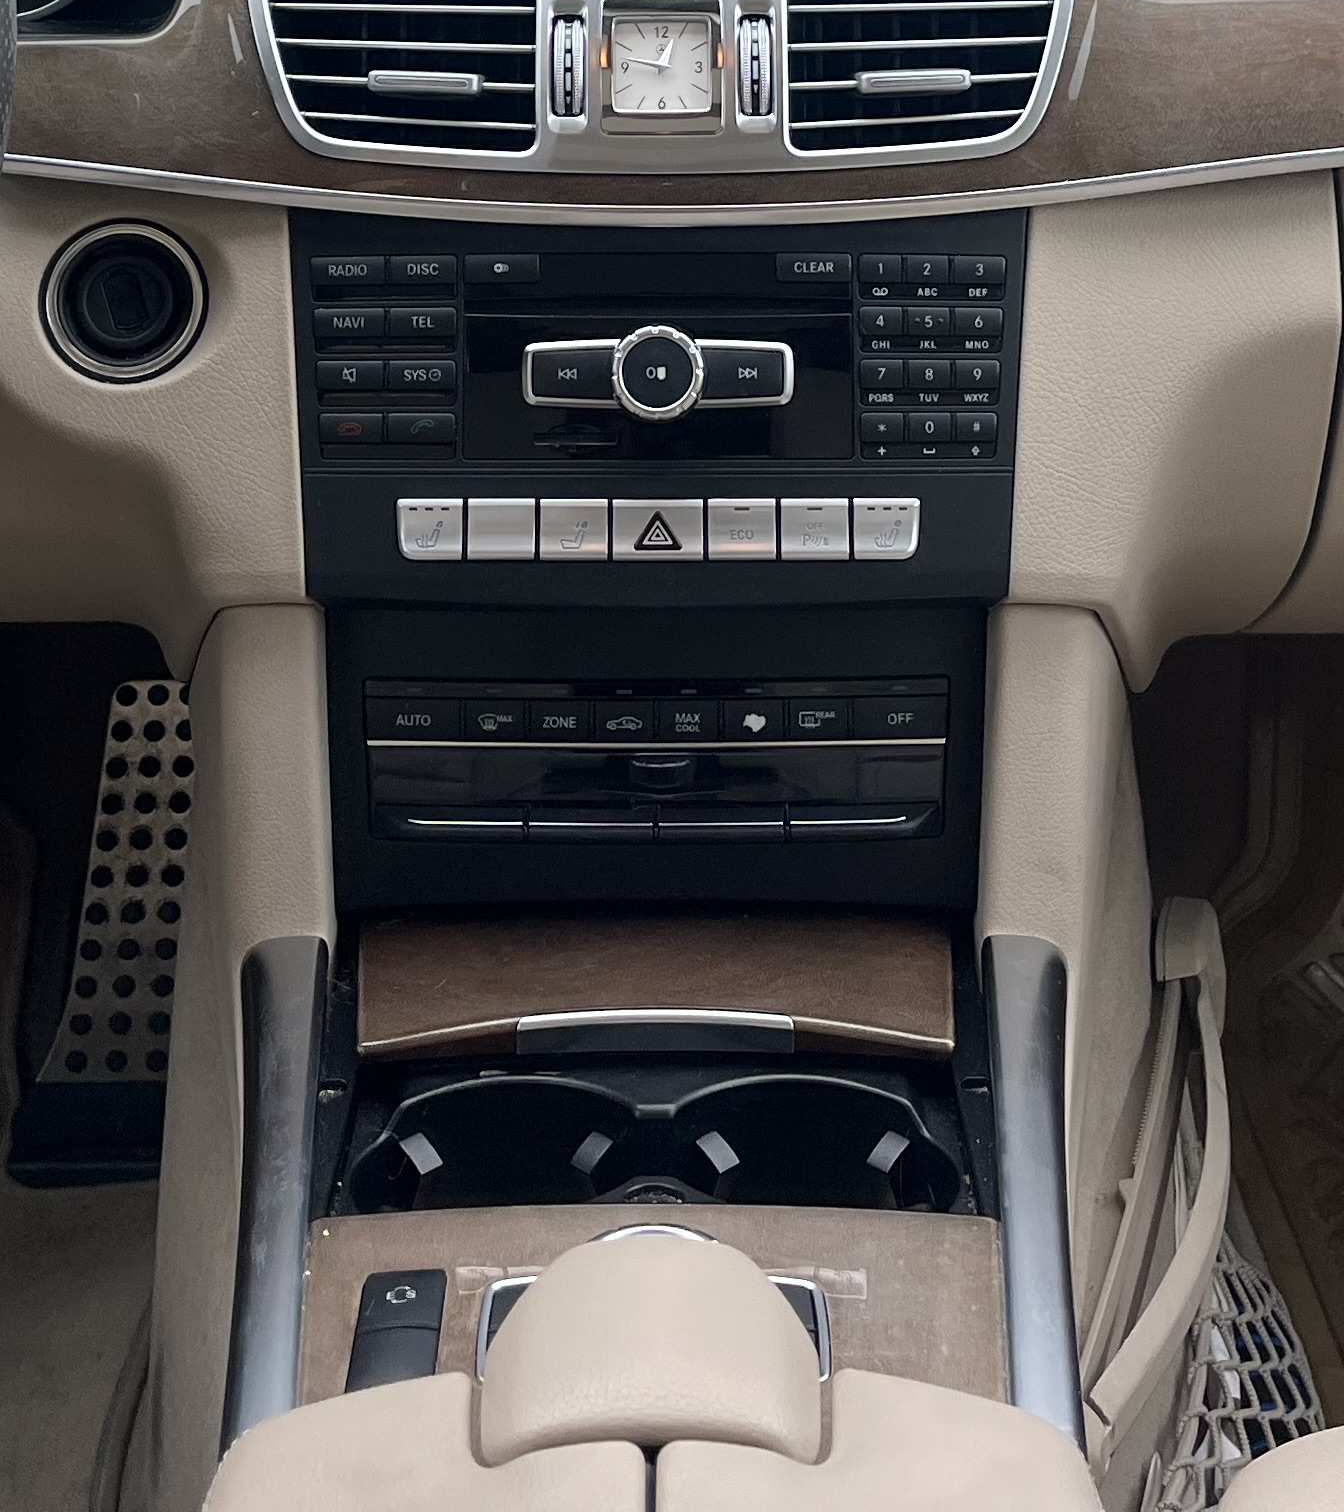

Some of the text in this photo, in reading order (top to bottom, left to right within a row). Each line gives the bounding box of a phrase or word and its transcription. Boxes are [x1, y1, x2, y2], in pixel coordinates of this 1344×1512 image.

[654, 26, 669, 39] 12
[621, 61, 629, 74] 9
[695, 61, 703, 74] 3
[658, 96, 666, 110] 6
[328, 264, 368, 276] RADIO
[407, 263, 440, 276] DISC
[793, 261, 835, 273] CLEAR
[878, 263, 884, 274] 1
[922, 263, 931, 276] 2
[975, 264, 984, 276] 3
[917, 288, 938, 297] ABC
[968, 288, 988, 297] DEF
[333, 317, 365, 329] NAVI
[411, 316, 435, 328] TEL
[875, 314, 885, 327] 4
[924, 315, 933, 328] 5
[974, 316, 984, 328] 6
[871, 340, 891, 350] GHI
[919, 340, 937, 350] JKL
[965, 340, 989, 350] MNO
[404, 369, 427, 381] SYS
[877, 368, 886, 380] 7
[925, 368, 934, 380] 8
[973, 368, 982, 380] 9
[868, 393, 894, 403] PQRS
[919, 393, 940, 402] TUV
[964, 393, 989, 403] WXYZ
[925, 421, 934, 433] 0
[729, 529, 754, 541] ECO
[395, 714, 431, 727] AUTO
[542, 716, 577, 729] ZONE
[675, 713, 701, 724] MAX
[887, 713, 914, 725] OFF
[675, 724, 701, 733] COOL
